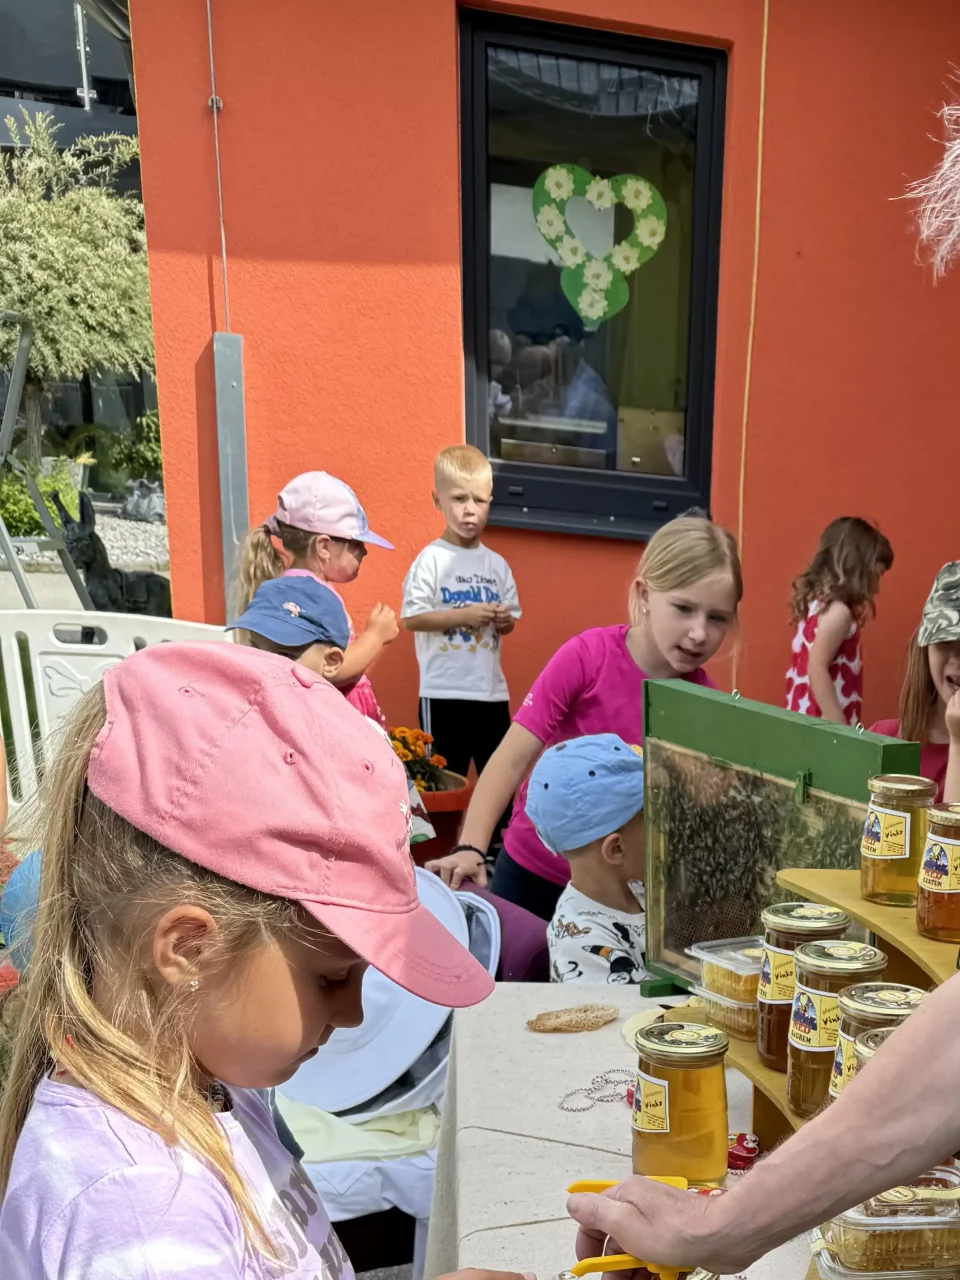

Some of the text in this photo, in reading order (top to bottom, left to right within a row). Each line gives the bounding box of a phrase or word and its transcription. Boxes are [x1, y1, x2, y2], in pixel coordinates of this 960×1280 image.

[440, 586, 484, 604] Donald
[885, 829, 904, 839] Vinko
[774, 970, 794, 981] Vinko
[821, 1013, 841, 1026] Vink
[644, 1100, 663, 1109] Vinko
